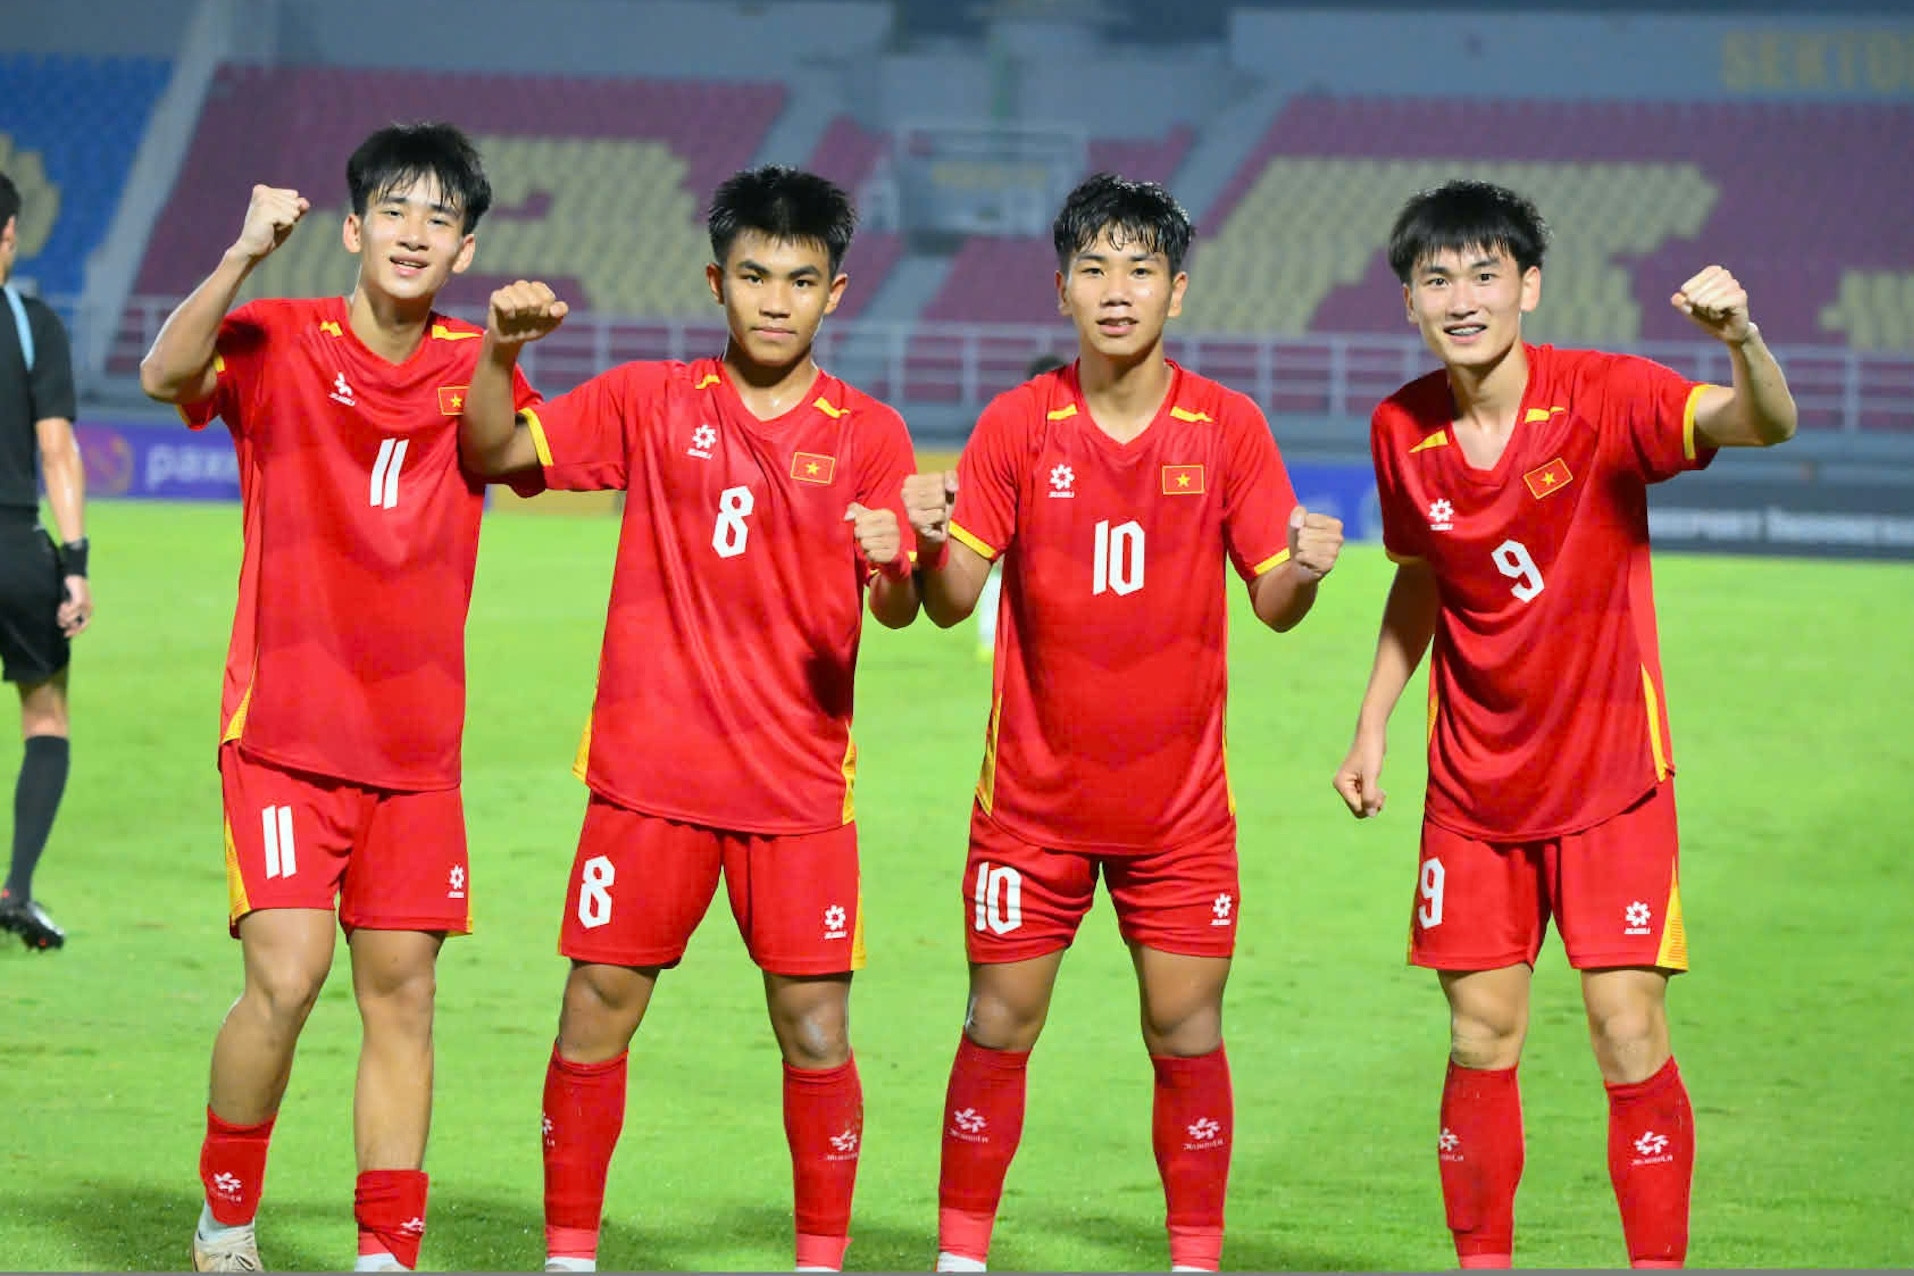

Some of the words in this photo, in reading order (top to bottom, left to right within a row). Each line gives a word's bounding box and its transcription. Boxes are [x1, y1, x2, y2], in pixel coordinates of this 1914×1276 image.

[1721, 32, 1914, 92] SEKTO
[369, 438, 409, 510] 11
[711, 485, 754, 559] 8
[1092, 519, 1146, 597] 10
[1491, 539, 1545, 604] 9
[261, 804, 297, 880] 11
[577, 855, 616, 929] 8
[974, 861, 1022, 935] 10
[1418, 857, 1446, 929] 9
